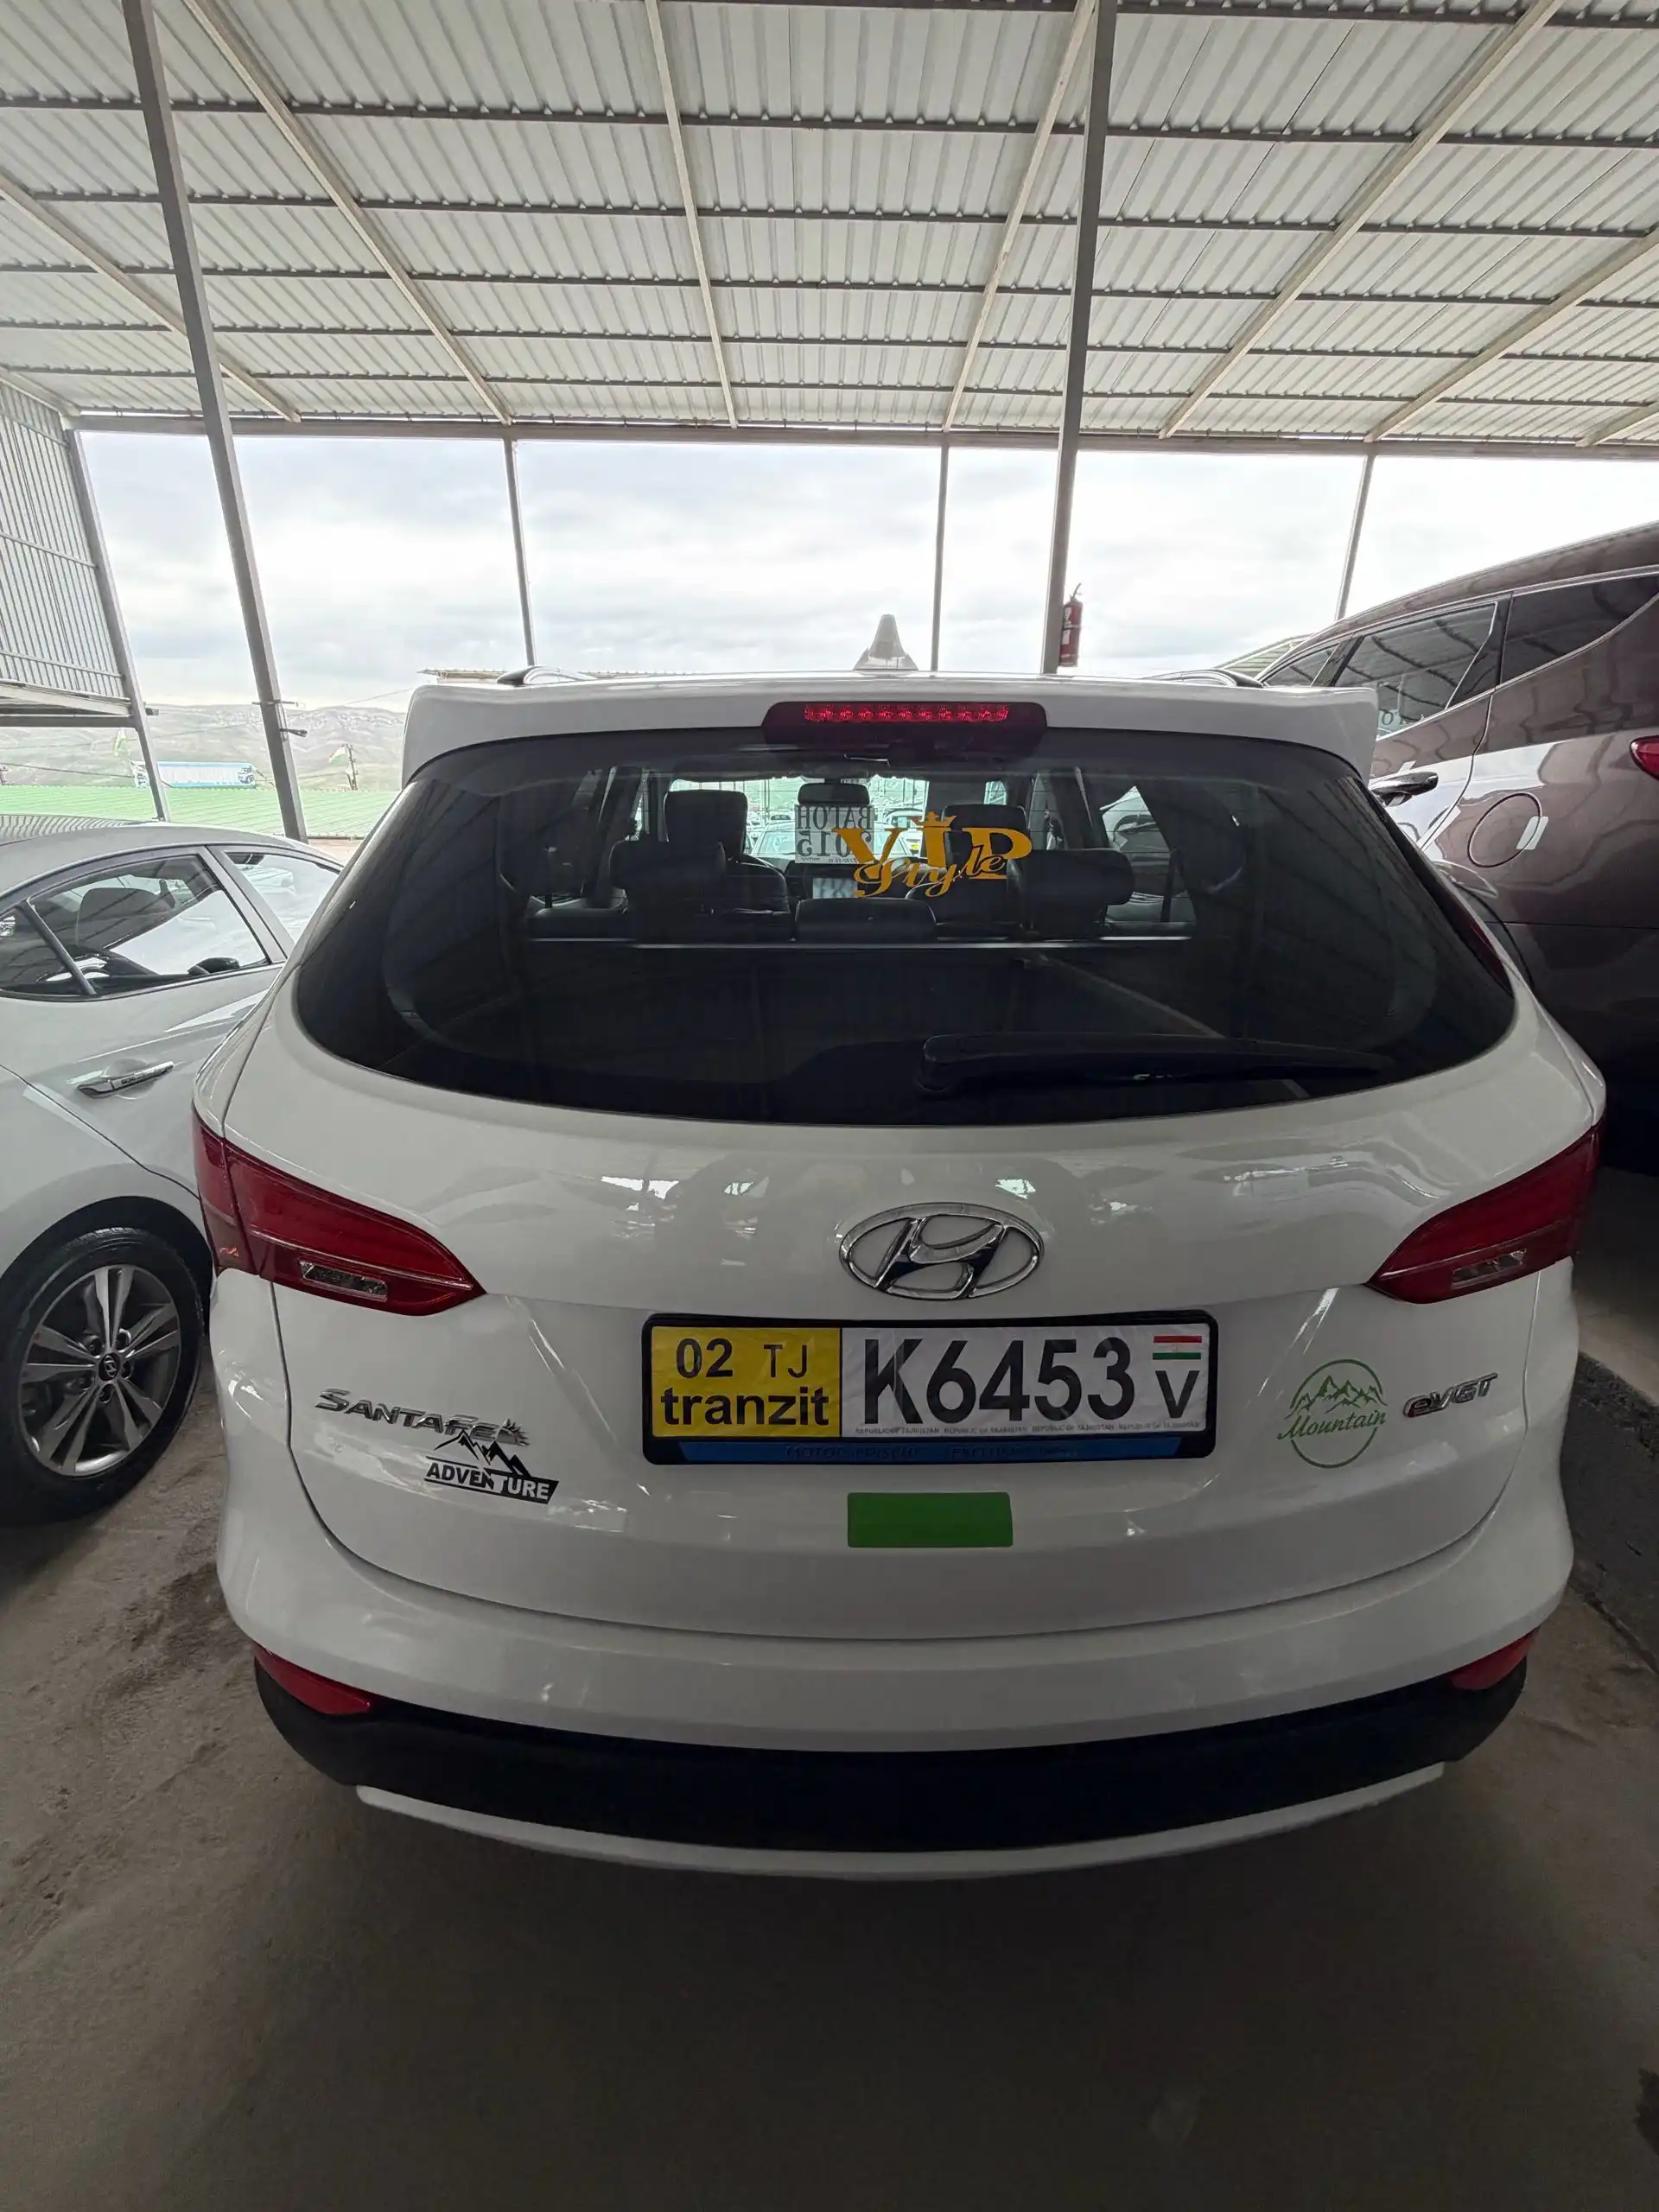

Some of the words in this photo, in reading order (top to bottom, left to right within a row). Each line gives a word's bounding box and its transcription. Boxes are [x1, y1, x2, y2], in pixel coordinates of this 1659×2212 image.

[831, 826, 1032, 880] VIP
[676, 1338, 733, 1378] 02
[763, 1344, 809, 1379] TJ
[864, 1337, 1135, 1424] K6453
[1154, 1370, 1200, 1419] V
[660, 1386, 830, 1427] tranzit
[1277, 1409, 1386, 1440] Mountain
[426, 1462, 551, 1500] ADVENTURE
